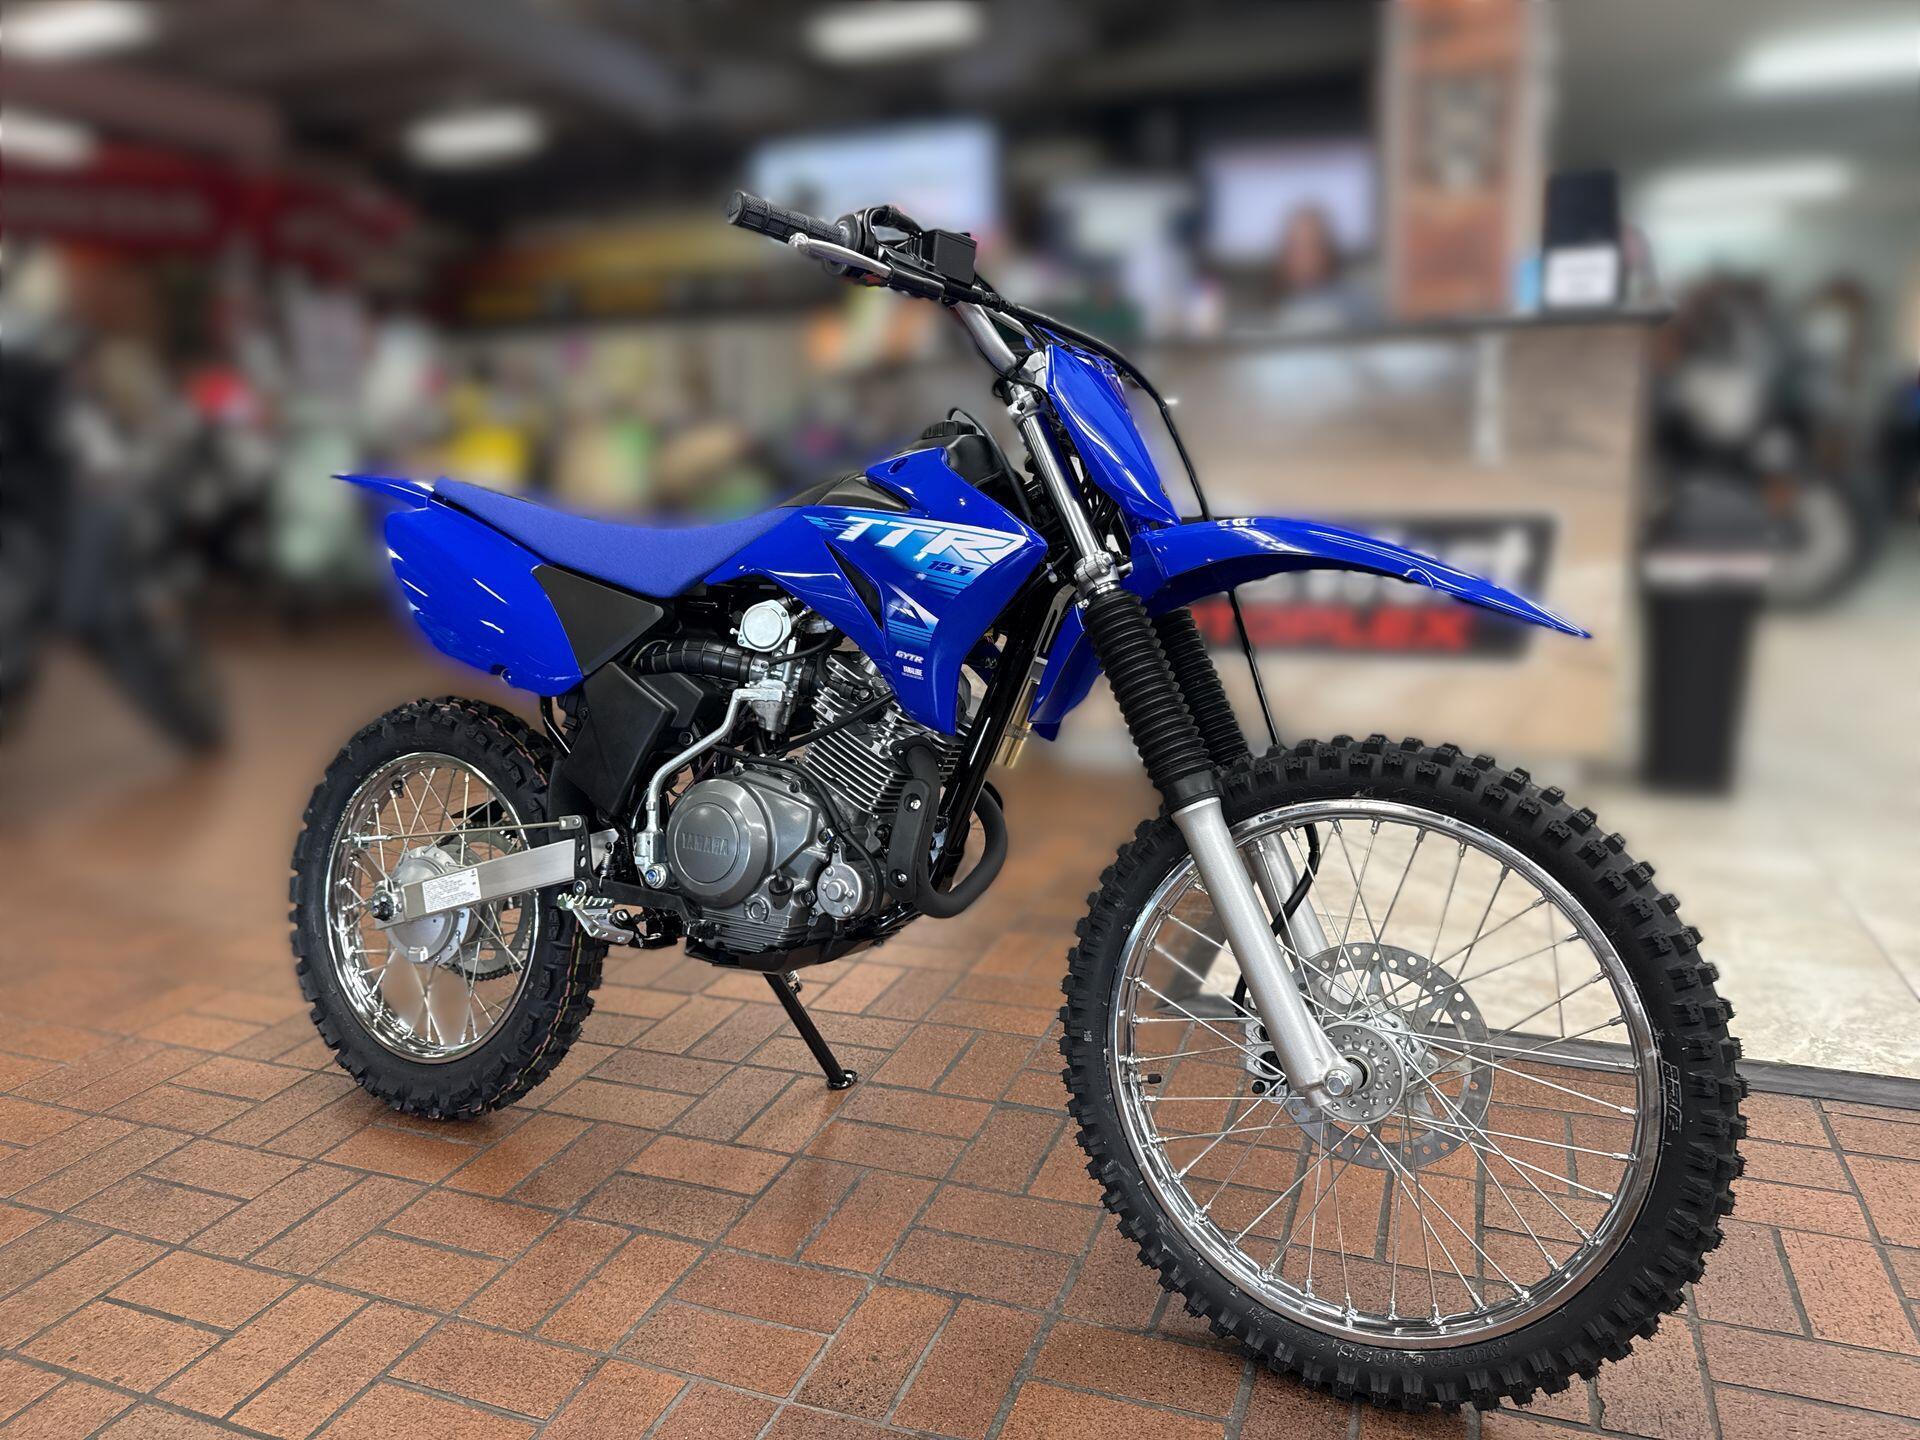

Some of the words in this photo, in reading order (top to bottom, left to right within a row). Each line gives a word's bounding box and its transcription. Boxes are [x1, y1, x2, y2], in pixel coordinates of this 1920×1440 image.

[836, 515, 1028, 565] TTR
[895, 650, 924, 664] GYTR
[682, 832, 729, 855] YAMAHA
